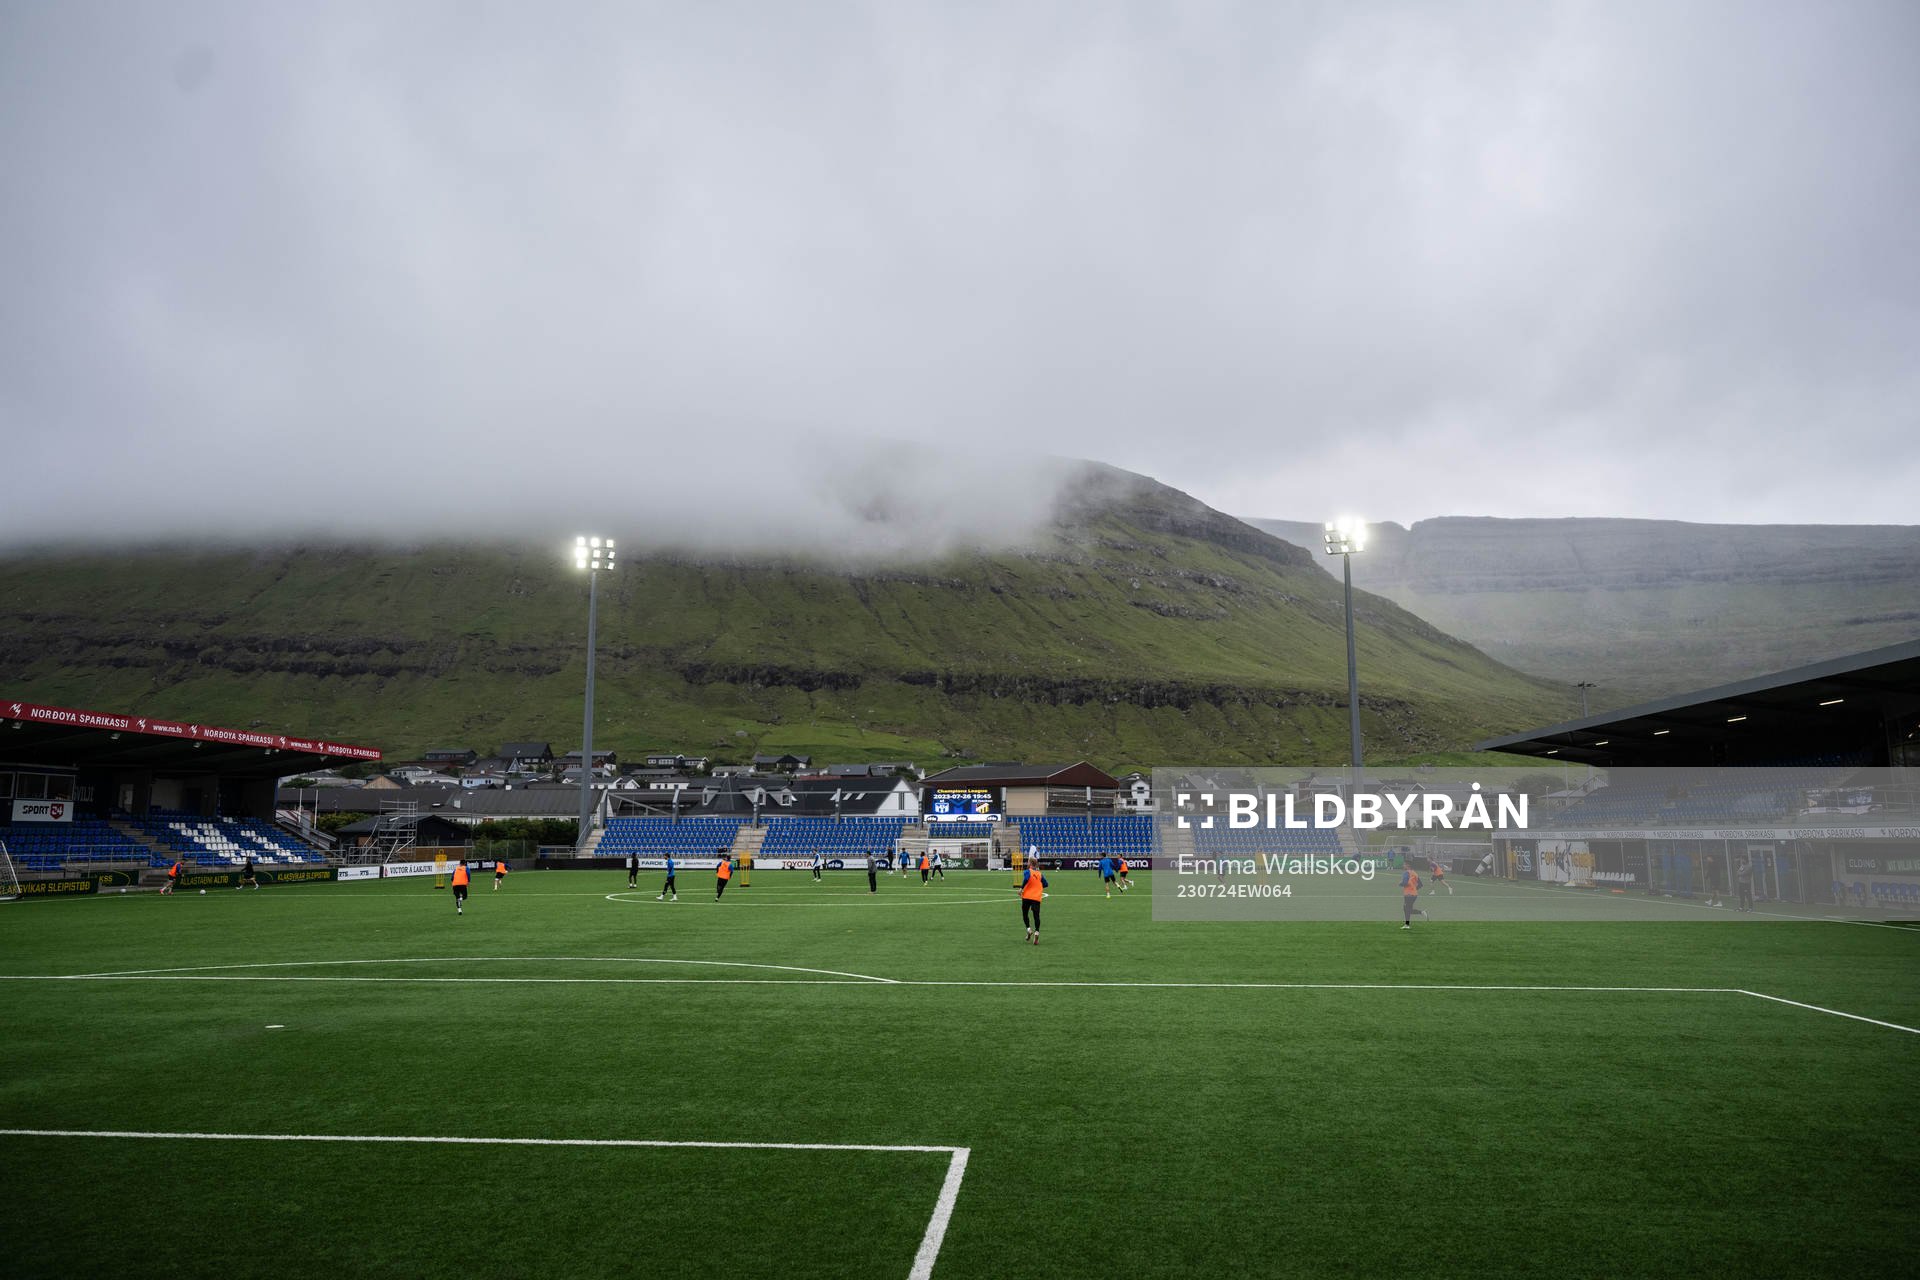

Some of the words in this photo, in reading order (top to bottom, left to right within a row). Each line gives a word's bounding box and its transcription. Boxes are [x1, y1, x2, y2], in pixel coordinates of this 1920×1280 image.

[31, 708, 76, 722] NORÐOYA
[79, 714, 129, 728] SPARIKASSI
[238, 733, 274, 745] SPARIKASSI
[22, 805, 49, 814] SPORT
[51, 804, 63, 815] 24
[390, 866, 408, 874] VICTOR
[98, 875, 113, 883] KSS
